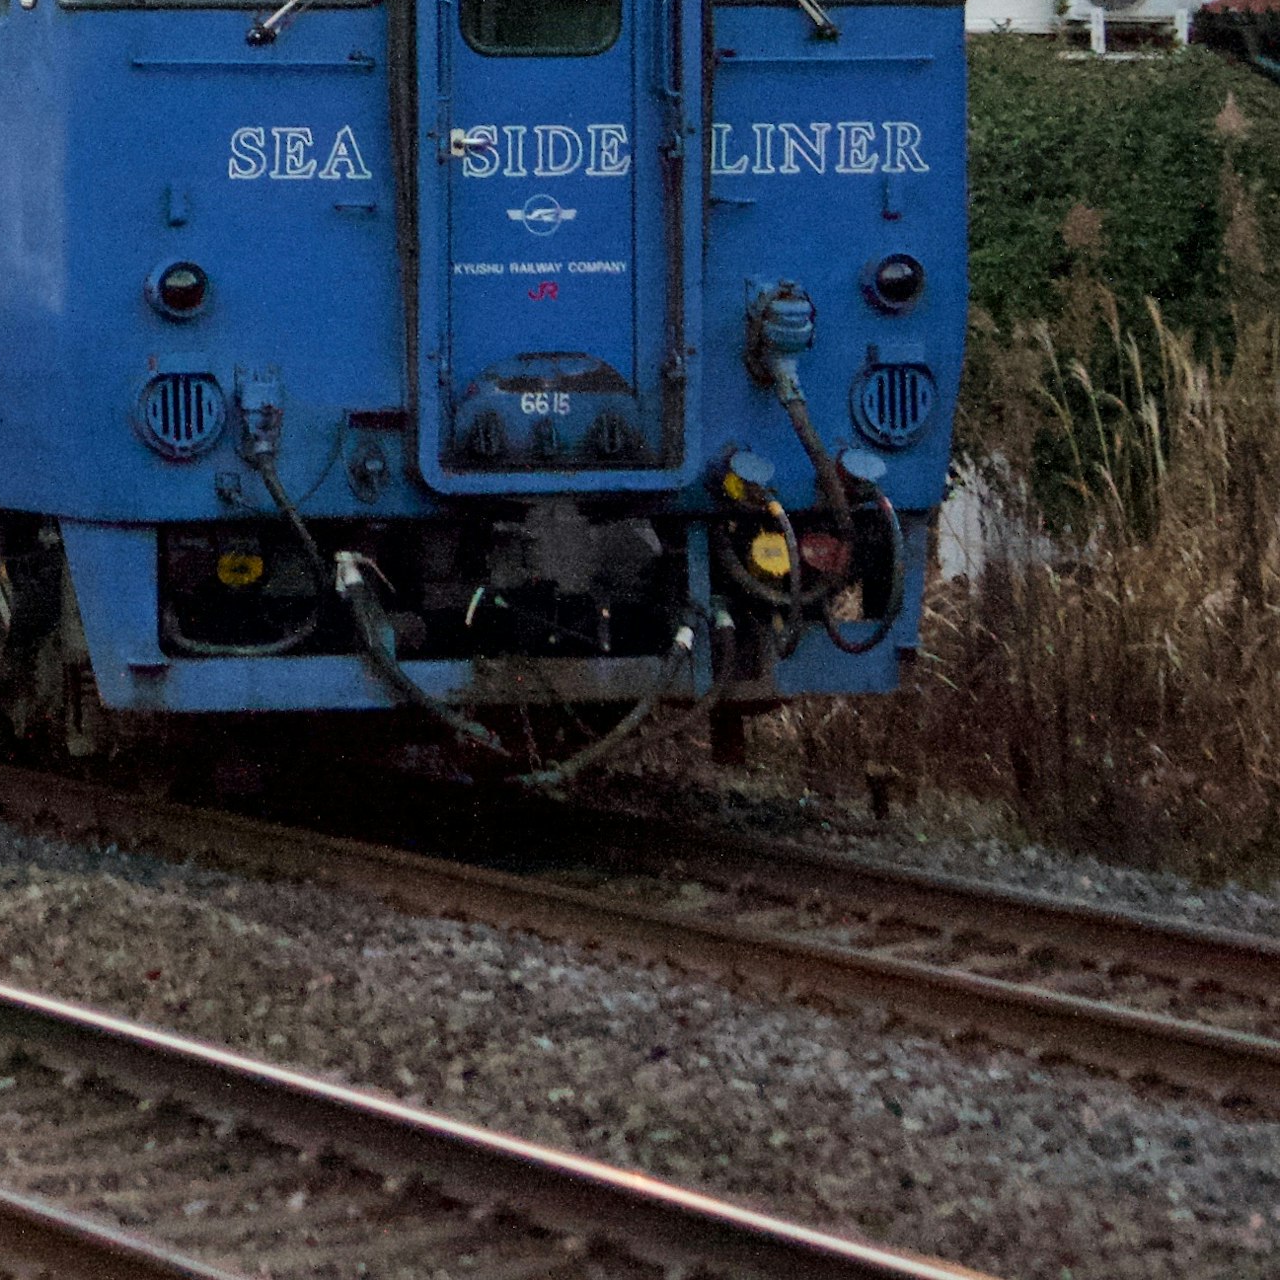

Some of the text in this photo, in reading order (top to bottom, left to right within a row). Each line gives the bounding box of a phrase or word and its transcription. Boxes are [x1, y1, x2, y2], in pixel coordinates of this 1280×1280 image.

[228, 122, 930, 180] SEA SIDE LINER
[453, 260, 628, 276] KYUSHU RAILWAY COMPANY
[527, 280, 560, 302] JR
[521, 392, 571, 416] 6615
